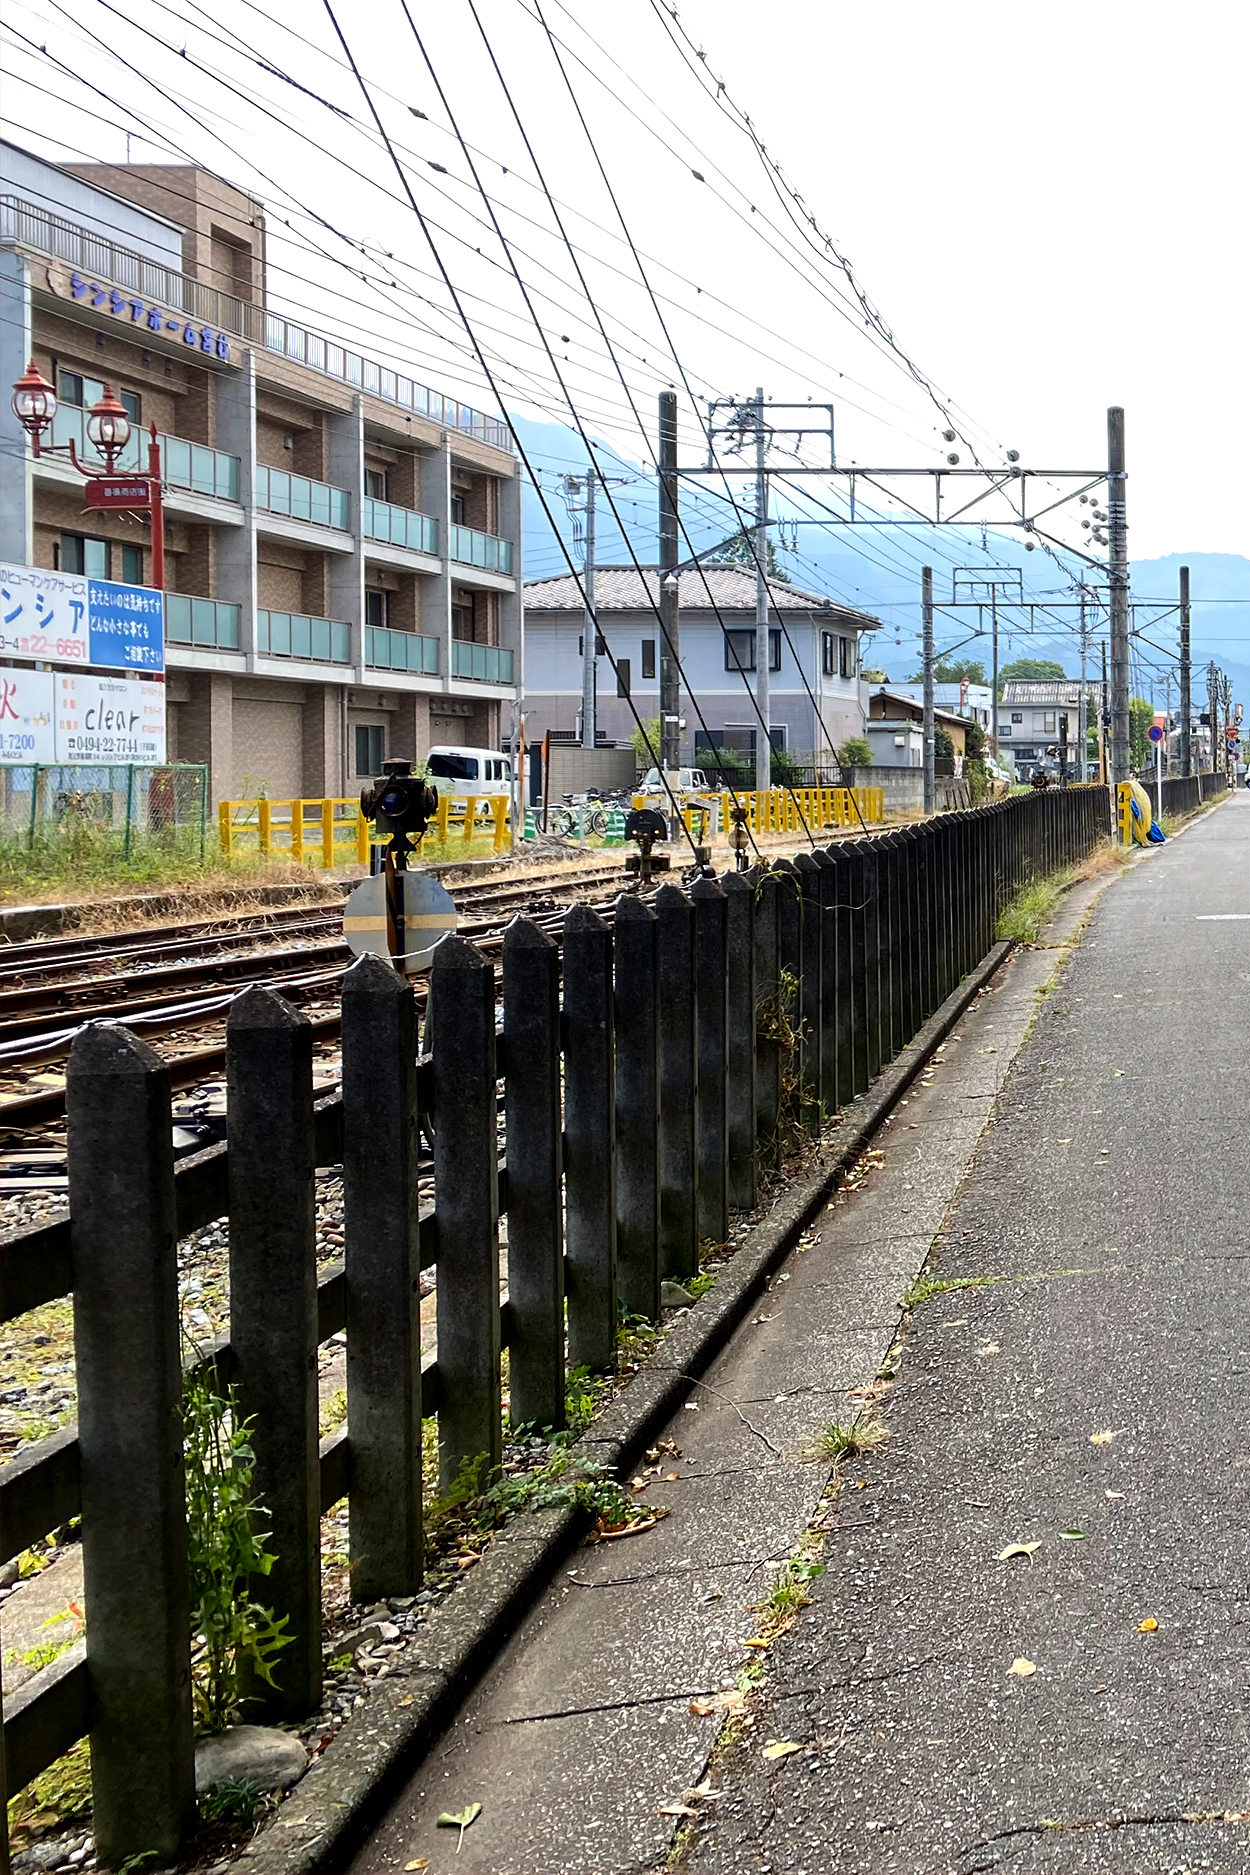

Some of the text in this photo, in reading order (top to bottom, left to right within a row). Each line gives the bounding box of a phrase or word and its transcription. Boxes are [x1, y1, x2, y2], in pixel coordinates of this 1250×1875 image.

[0, 569, 86, 596] のヒューマンケアサービス
[1, 587, 85, 634] ンシア
[89, 587, 161, 614] 支えたいのは気持ちです
[30, 634, 87, 659] 22-6651
[85, 698, 140, 732] clear
